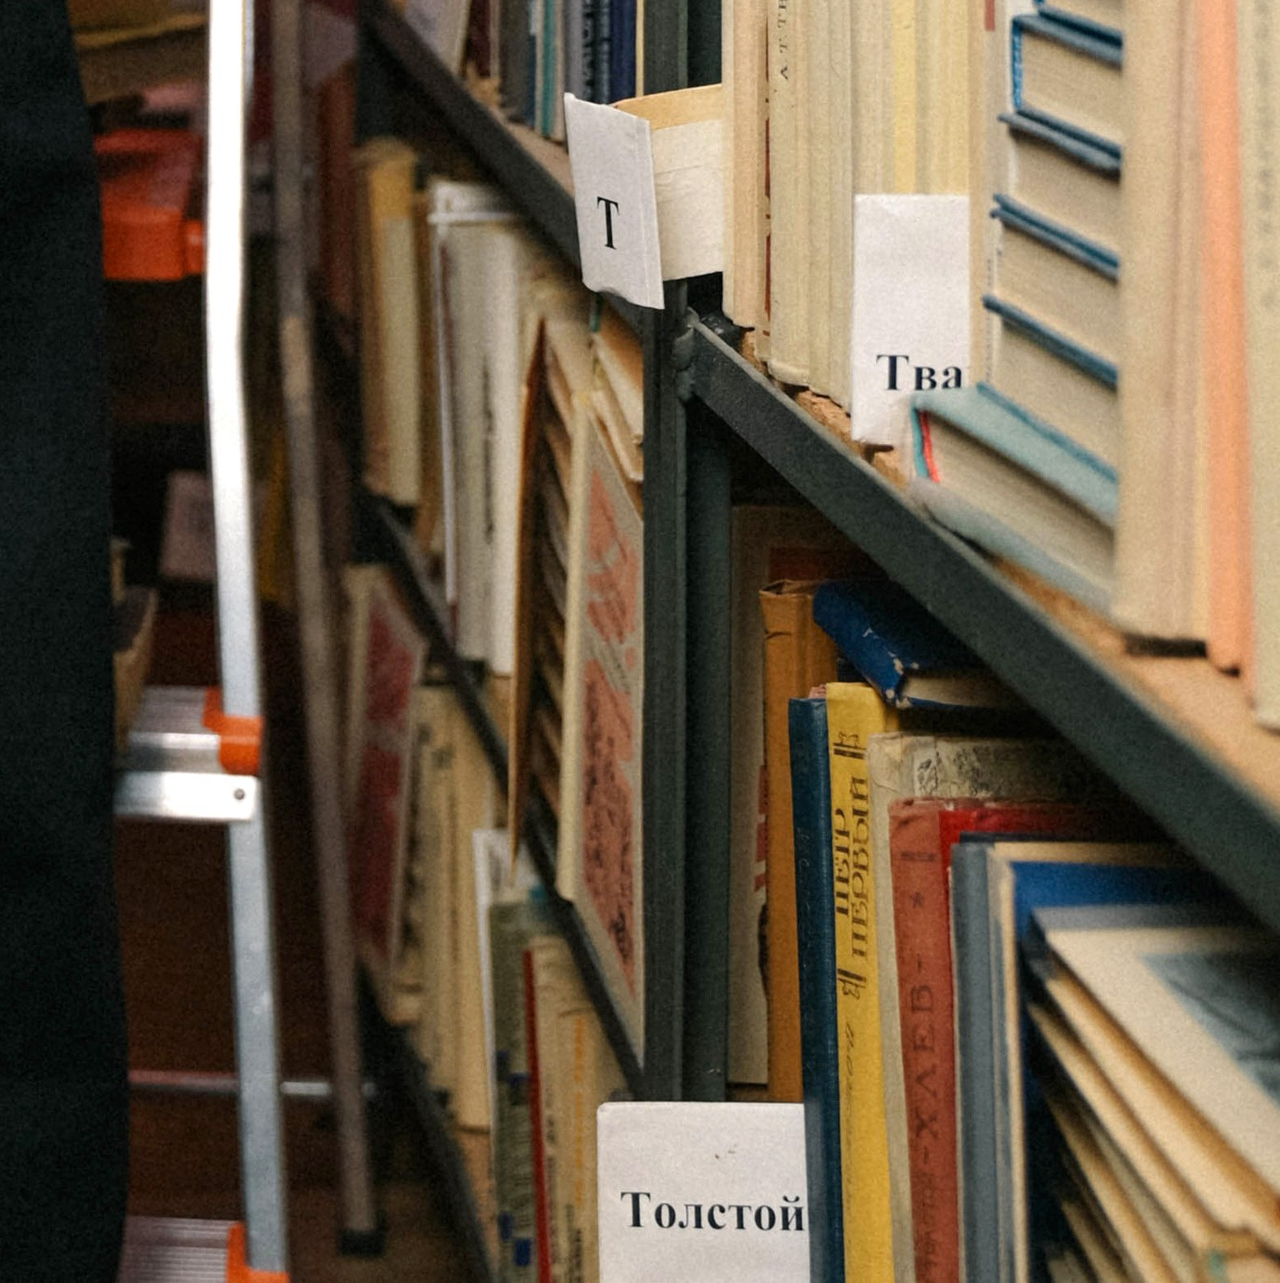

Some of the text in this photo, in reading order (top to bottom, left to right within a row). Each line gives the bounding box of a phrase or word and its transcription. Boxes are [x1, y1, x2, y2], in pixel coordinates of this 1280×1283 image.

[596, 196, 619, 249] Т
[876, 354, 963, 391] Тва
[849, 776, 869, 961] ПЕРВЫЙ
[620, 1191, 805, 1232] Толстой
